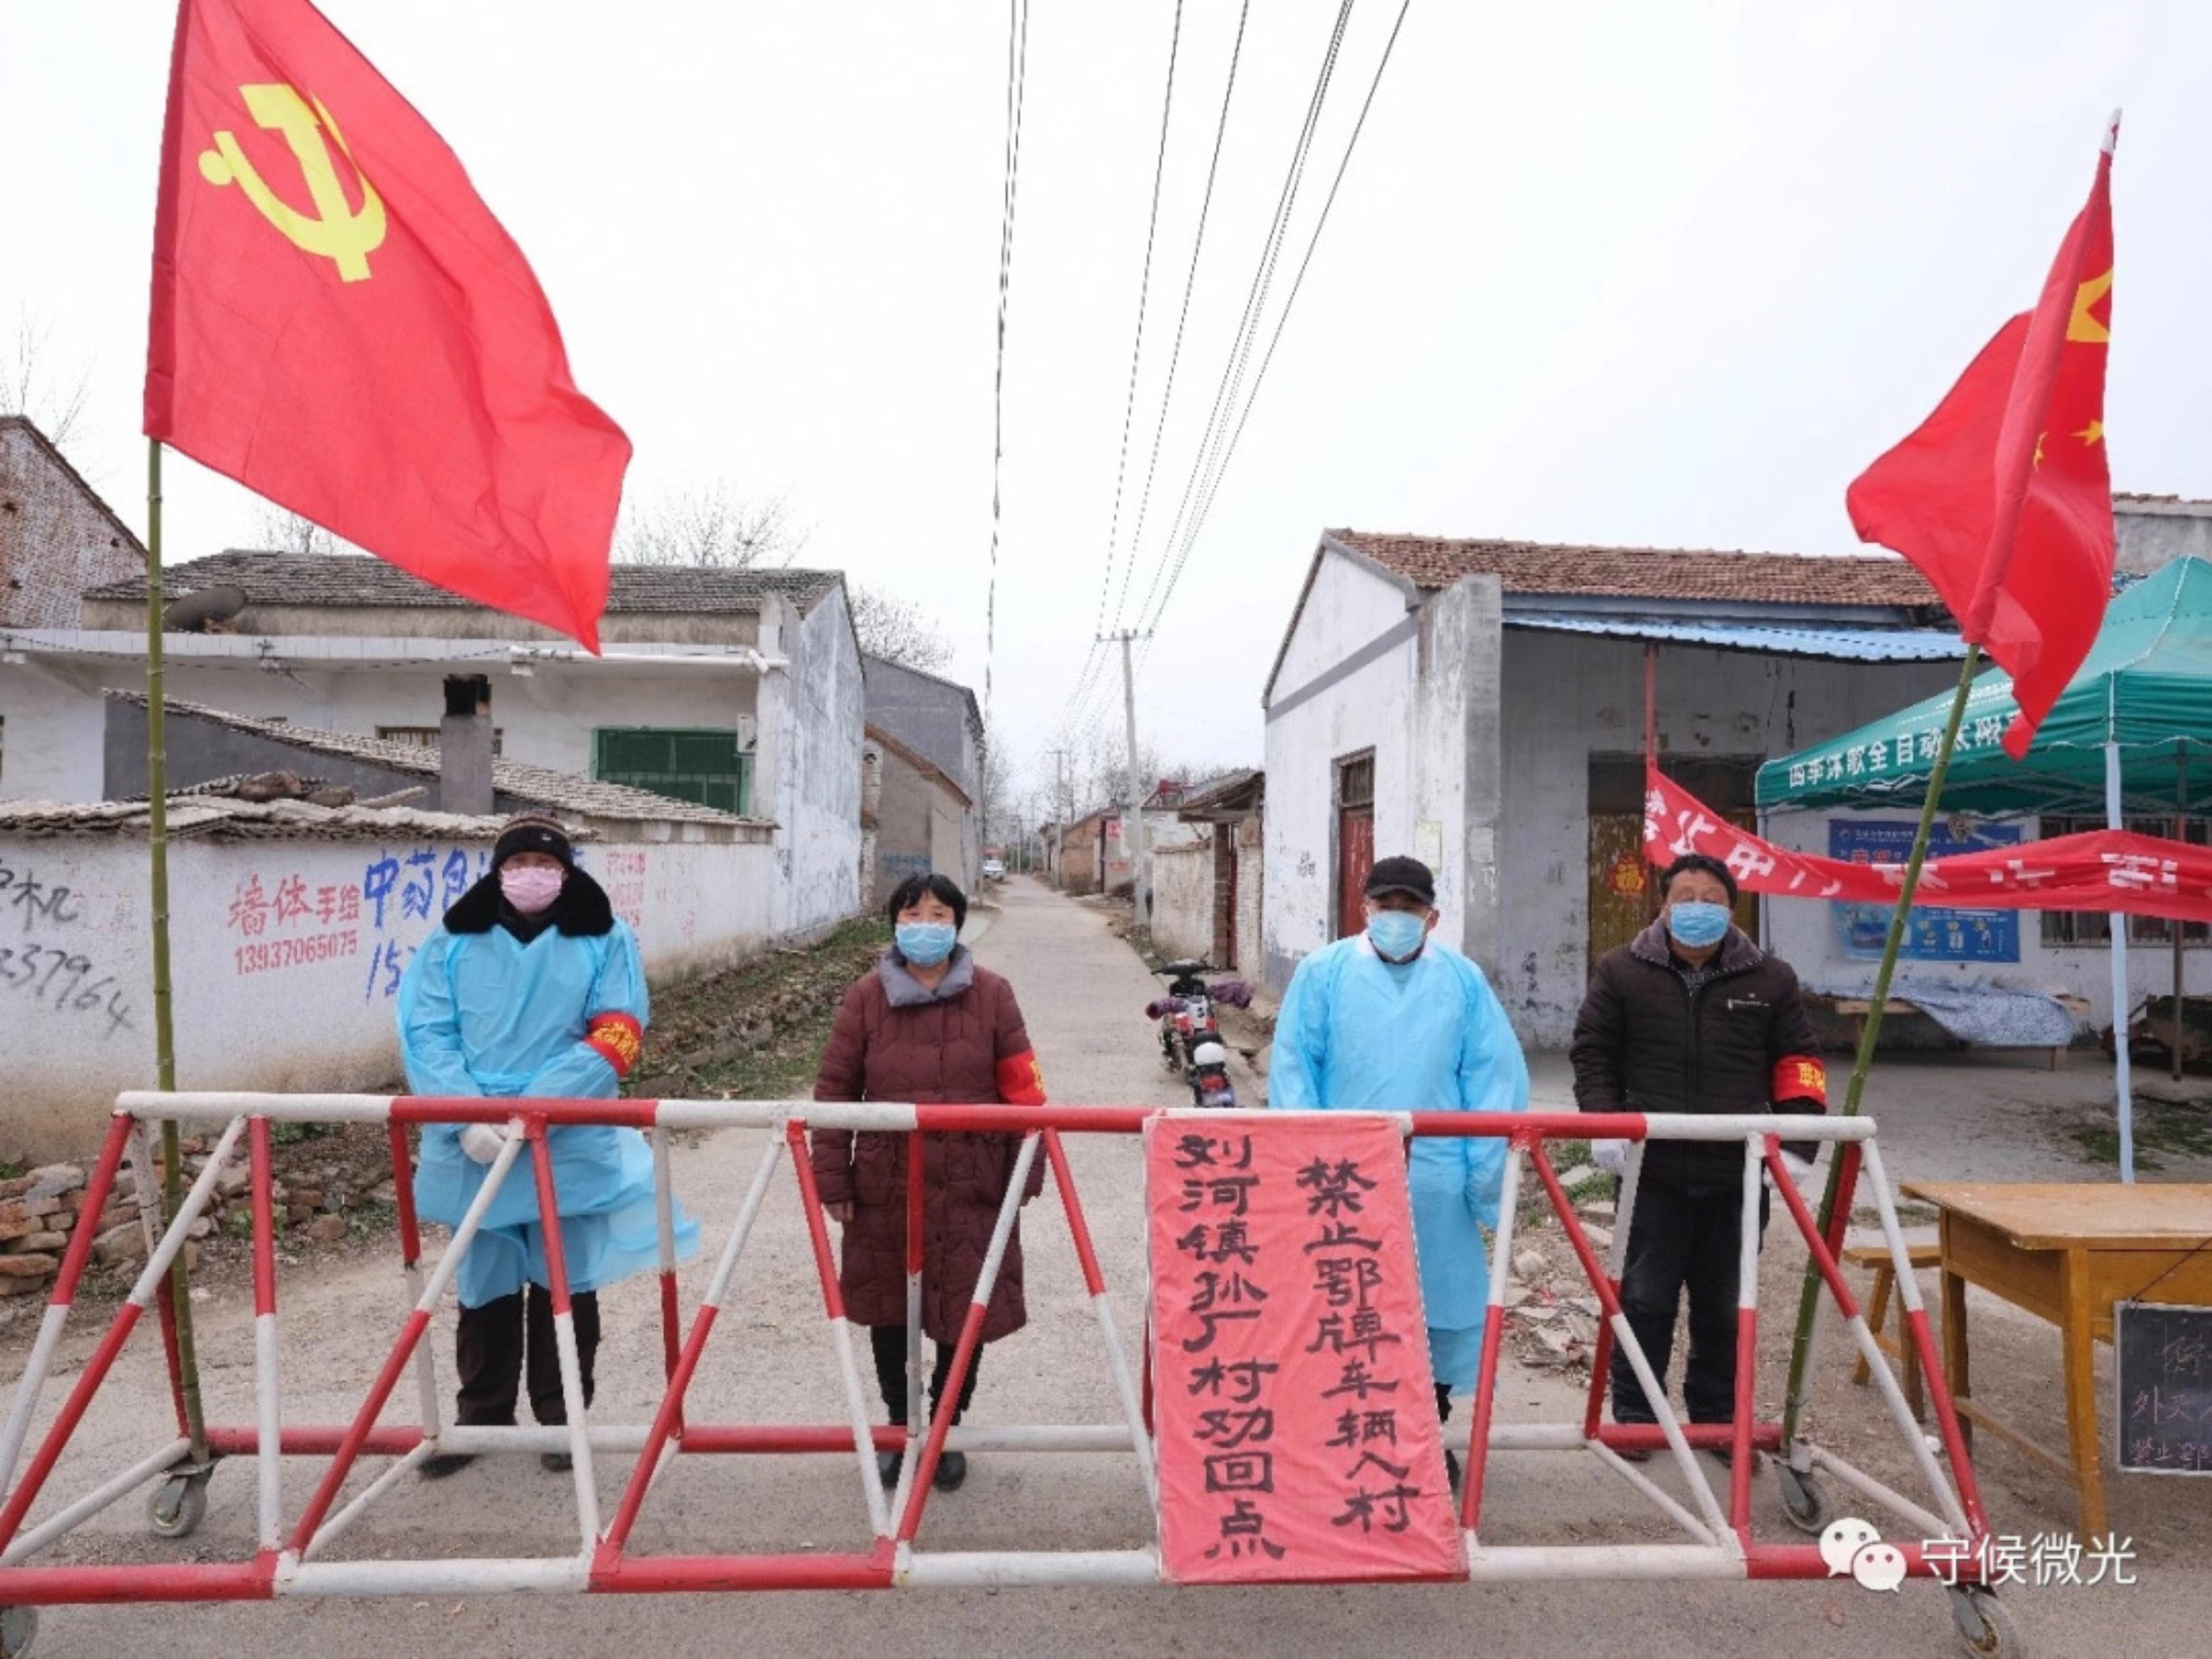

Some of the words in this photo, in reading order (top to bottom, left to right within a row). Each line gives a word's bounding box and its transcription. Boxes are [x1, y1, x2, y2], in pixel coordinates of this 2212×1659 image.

[227, 874, 360, 936] 墙体手绘
[1295, 1156, 1421, 1532] 禁止鄂牌车辆入村
